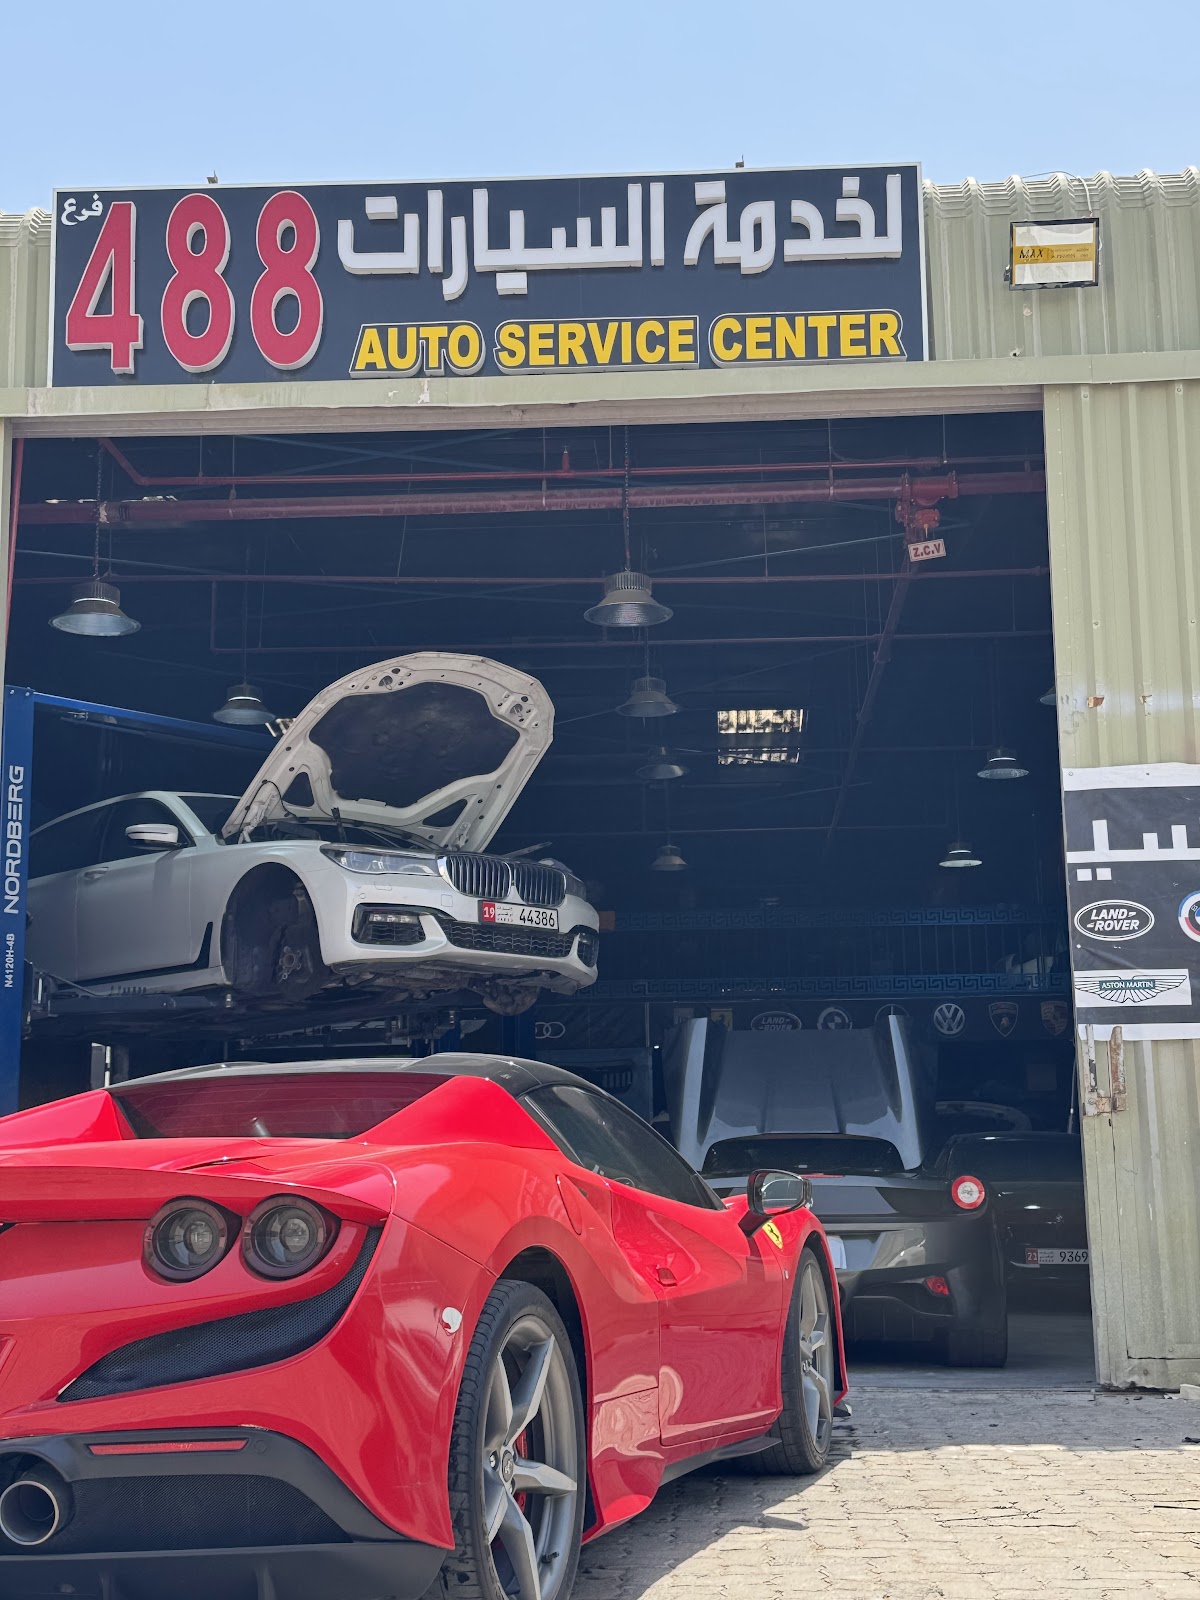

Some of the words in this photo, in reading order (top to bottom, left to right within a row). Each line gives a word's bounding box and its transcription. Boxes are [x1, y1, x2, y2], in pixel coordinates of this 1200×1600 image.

[61, 193, 103, 225] فرع
[683, 173, 902, 275] لخدمة
[337, 181, 665, 301] السيارات
[66, 190, 324, 375] 488
[354, 323, 481, 371] AUTO
[499, 318, 695, 367] SERVICE
[711, 312, 901, 361] CENTER
[912, 543, 941, 558] Z.C.V
[3, 764, 25, 915] NORDBERG
[483, 906, 495, 919] 19
[519, 908, 555, 928] 44386
[1090, 908, 1128, 921] LAND
[1094, 919, 1140, 932] ROVER
[1101, 981, 1126, 989] ASTON
[1126, 980, 1154, 989] MARTIN
[761, 1016, 785, 1025] LAND
[1059, 1250, 1089, 1263] 9369
